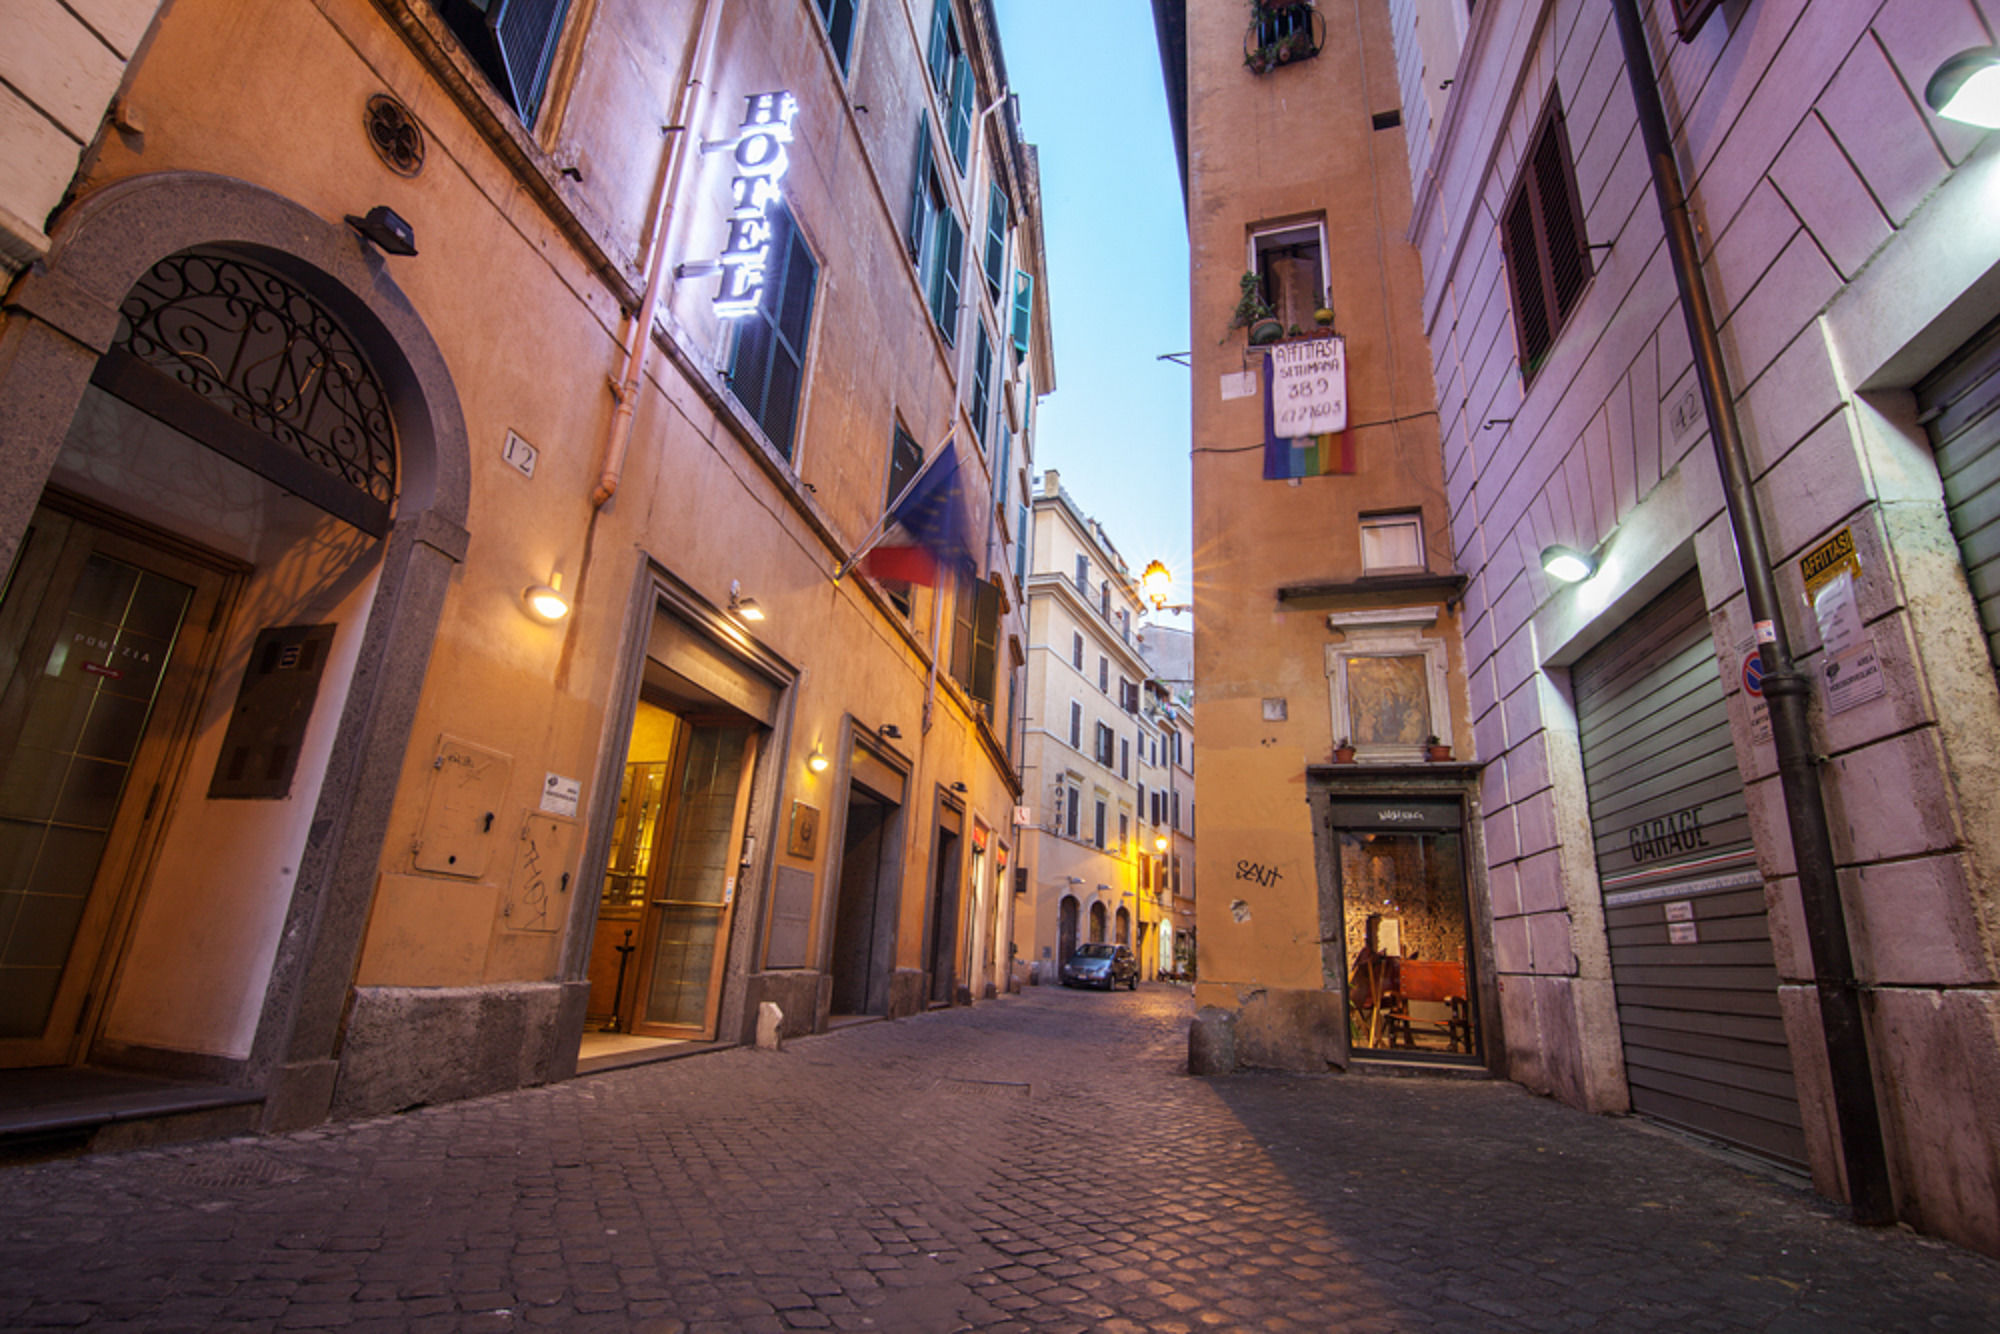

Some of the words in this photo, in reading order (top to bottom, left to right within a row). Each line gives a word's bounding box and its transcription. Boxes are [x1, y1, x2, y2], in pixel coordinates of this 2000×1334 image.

[712, 90, 797, 314] HOTEL
[507, 437, 533, 472] 12
[1801, 529, 1851, 580] AFFITTASI
[74, 633, 149, 663] POMZIA
[1629, 807, 1710, 863] GARAGE
